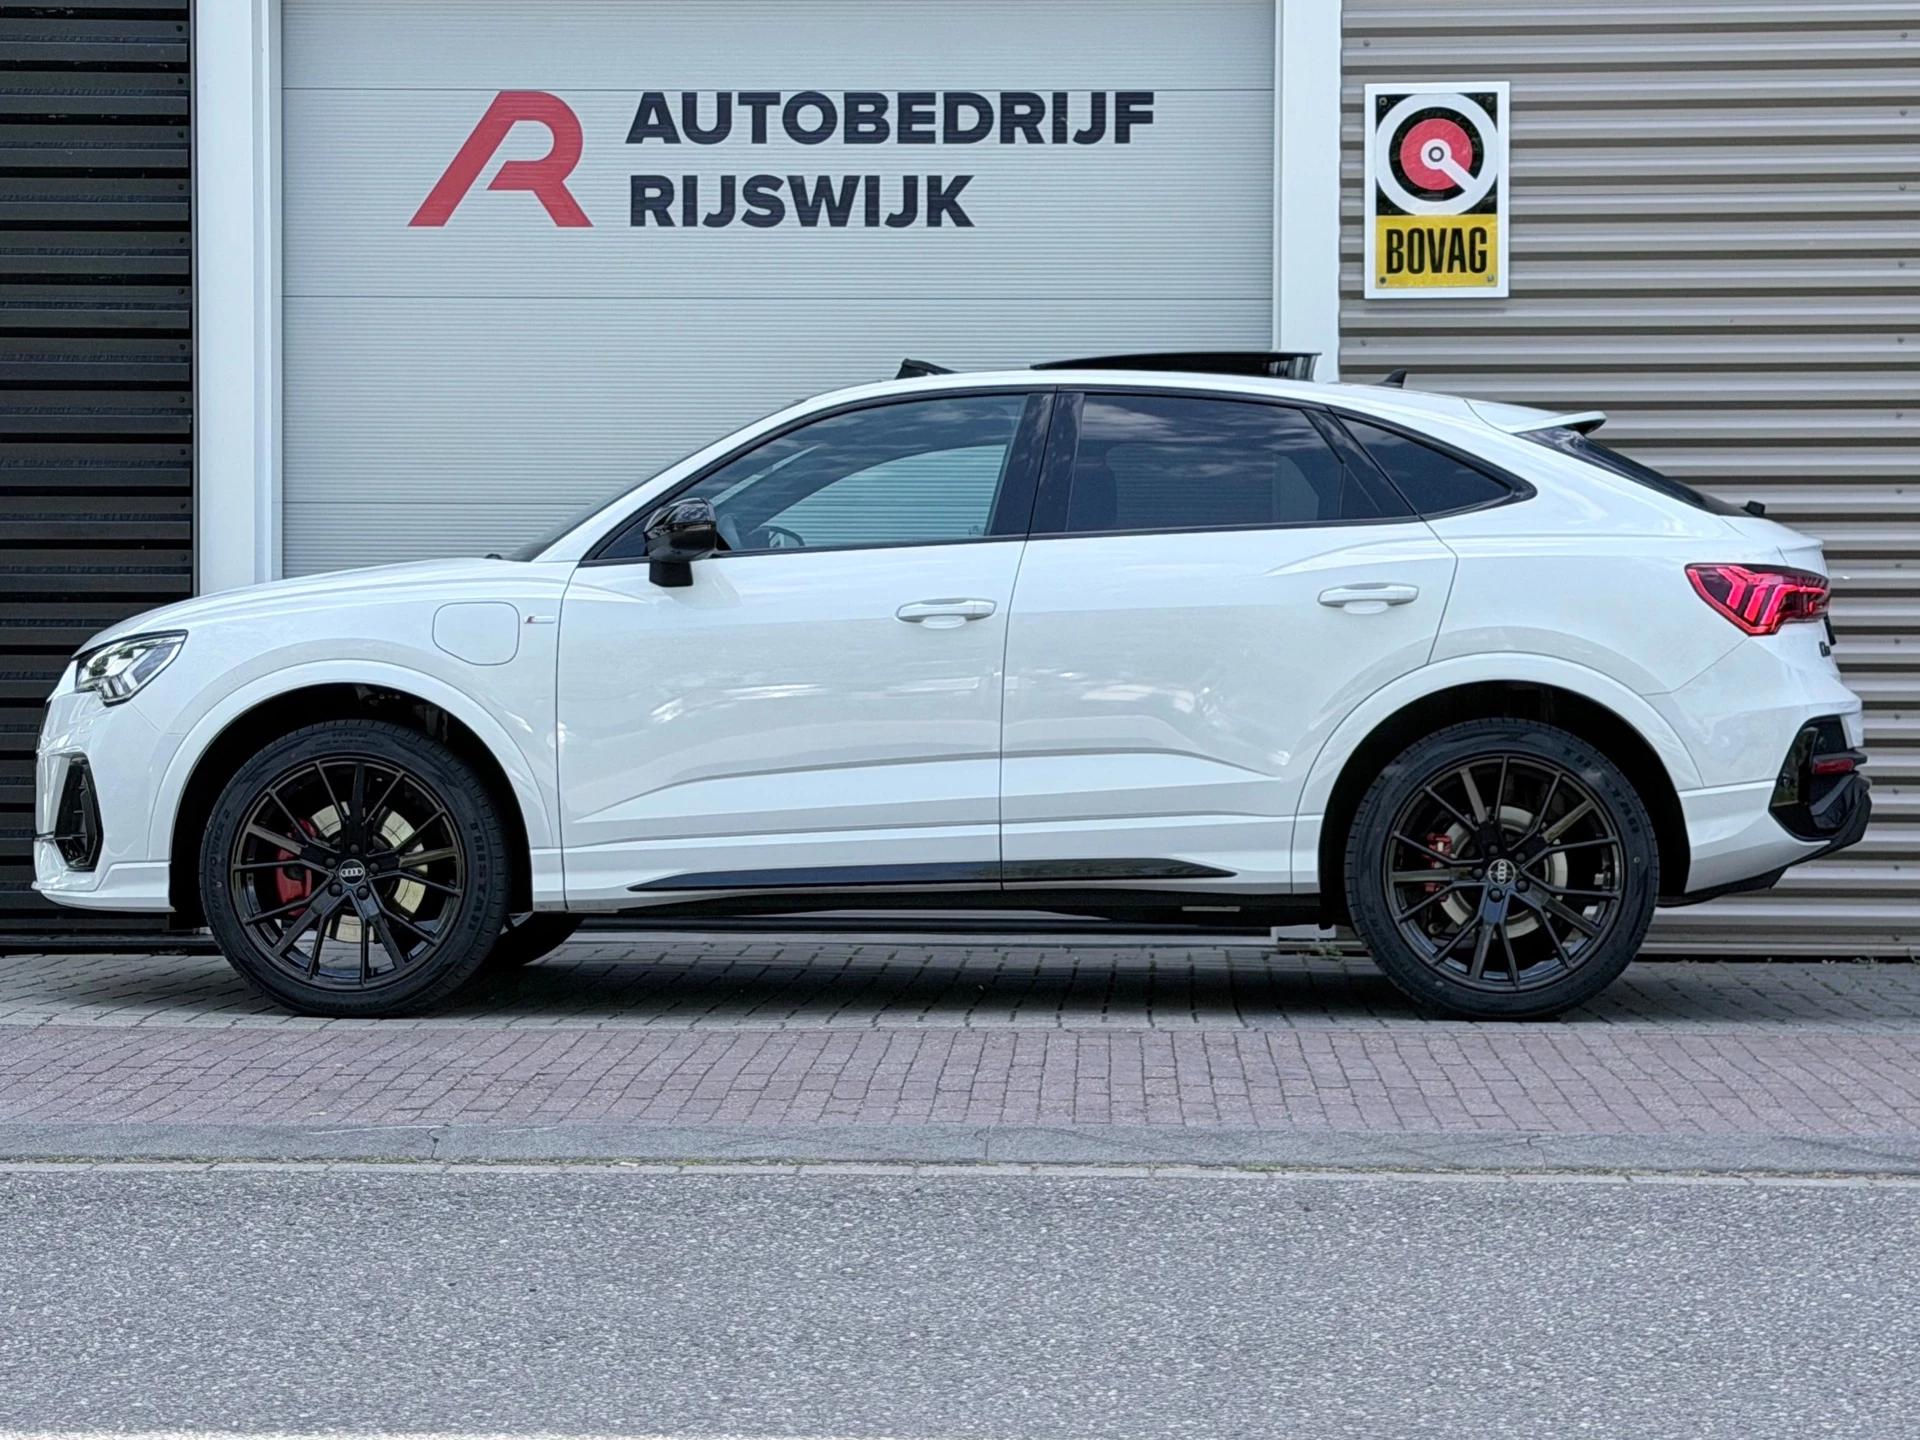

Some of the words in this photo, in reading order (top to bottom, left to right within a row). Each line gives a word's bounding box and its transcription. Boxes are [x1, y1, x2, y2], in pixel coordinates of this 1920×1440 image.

[625, 90, 1155, 145] AUTOBEDRIJF
[629, 174, 974, 228] RIJSWIJK
[1386, 227, 1487, 275] BOVAG
